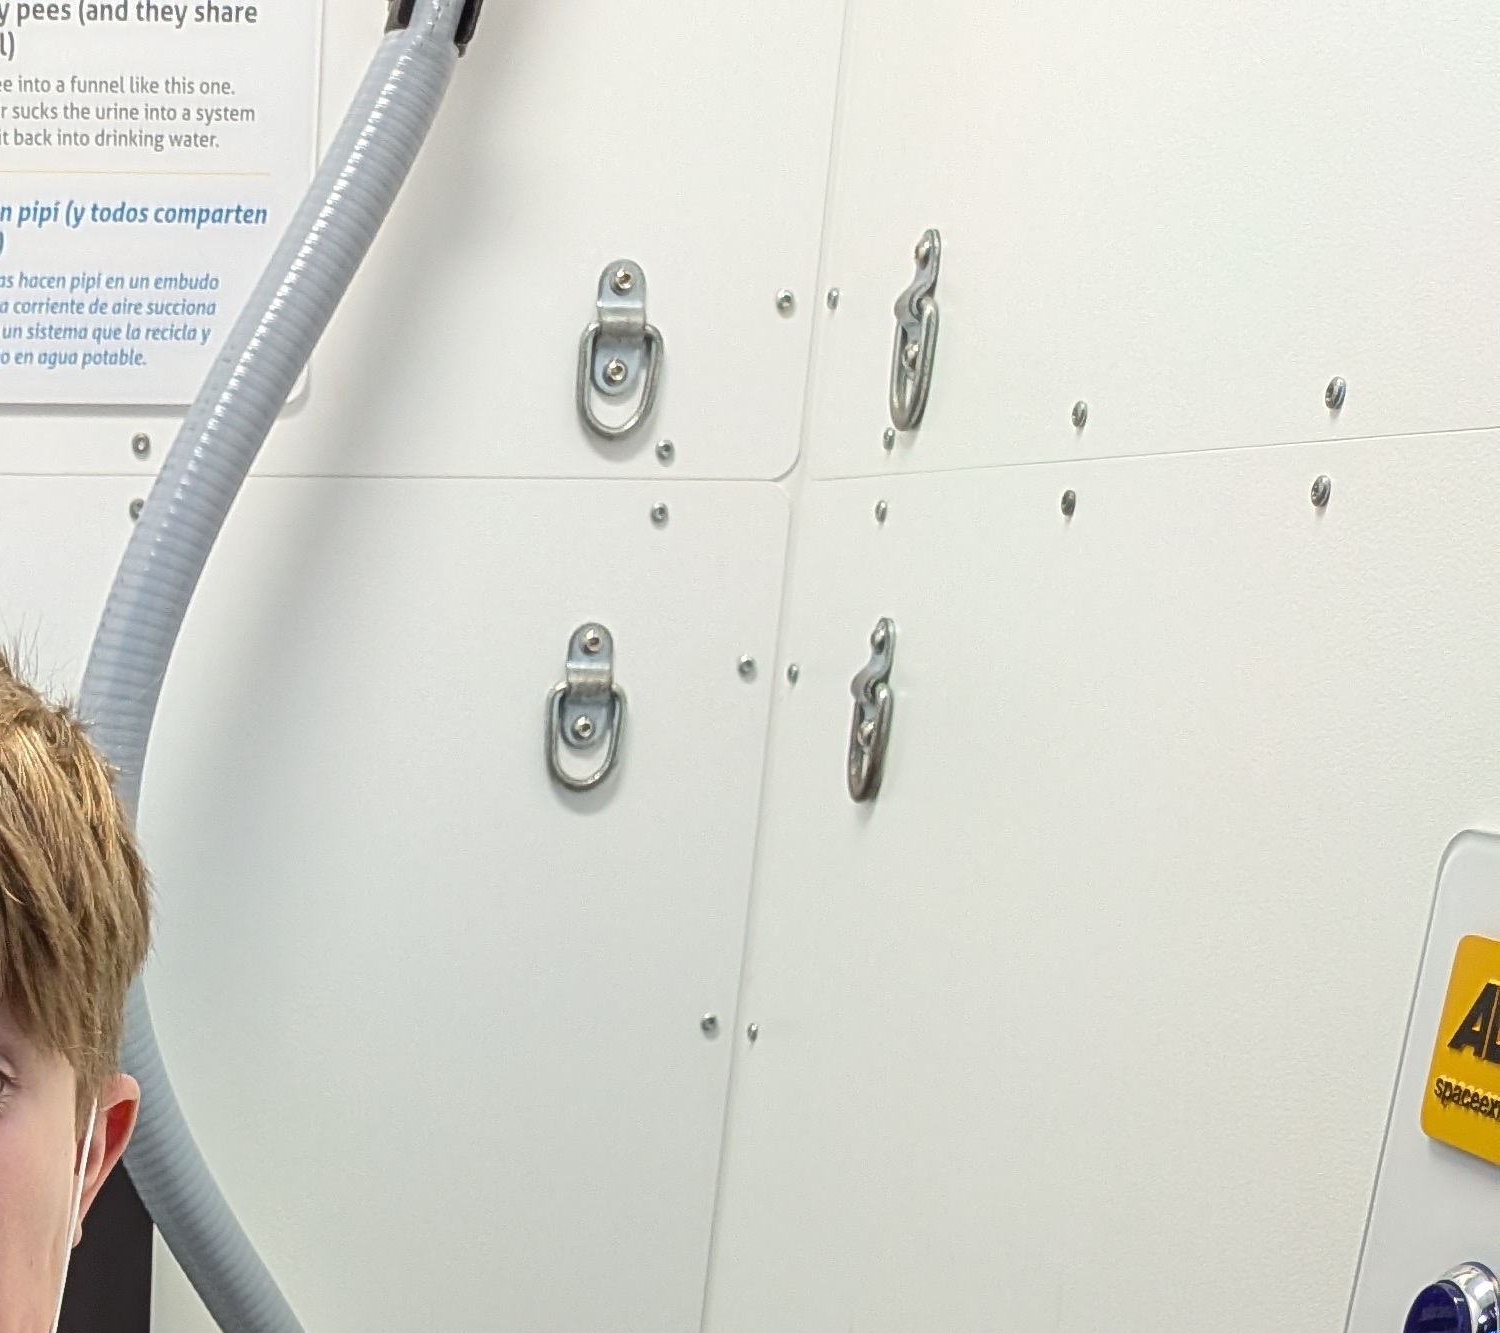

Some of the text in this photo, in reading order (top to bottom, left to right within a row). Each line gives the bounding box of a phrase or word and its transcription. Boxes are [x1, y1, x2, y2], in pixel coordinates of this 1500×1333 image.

[16, 2, 72, 27] pees
[78, 0, 129, 25] (and
[135, 0, 189, 29] they
[194, 0, 258, 24] share
[17, 73, 52, 94] into
[55, 79, 66, 94] a
[69, 74, 126, 94] funnel
[129, 75, 160, 95] like
[164, 75, 196, 95] this
[199, 81, 236, 96] one.
[11, 101, 59, 120] sucks
[62, 101, 91, 121] the
[95, 102, 140, 121] urine
[144, 102, 178, 122] into
[181, 107, 191, 122] a
[195, 106, 256, 126] system
[13, 127, 53, 147] back
[56, 127, 91, 147] into
[94, 127, 165, 153] drinking
[168, 132, 220, 149] water.
[65, 199, 86, 229] (y
[90, 201, 150, 224] todos
[153, 203, 268, 229] comparten
[17, 270, 67, 290] hacen
[104, 276, 125, 290] en
[128, 276, 151, 290] un
[153, 272, 220, 291] embudo
[12, 296, 85, 315] corriente
[88, 296, 109, 316] de
[111, 296, 144, 316] aire
[145, 297, 217, 317] succiona
[1, 325, 23, 340] un
[25, 322, 89, 341] sistema
[91, 325, 123, 346] que
[124, 322, 142, 341] la
[144, 322, 198, 342] recicla
[200, 327, 212, 346] y
[13, 351, 35, 365] en
[37, 351, 79, 370] agua
[80, 348, 147, 370] potable.
